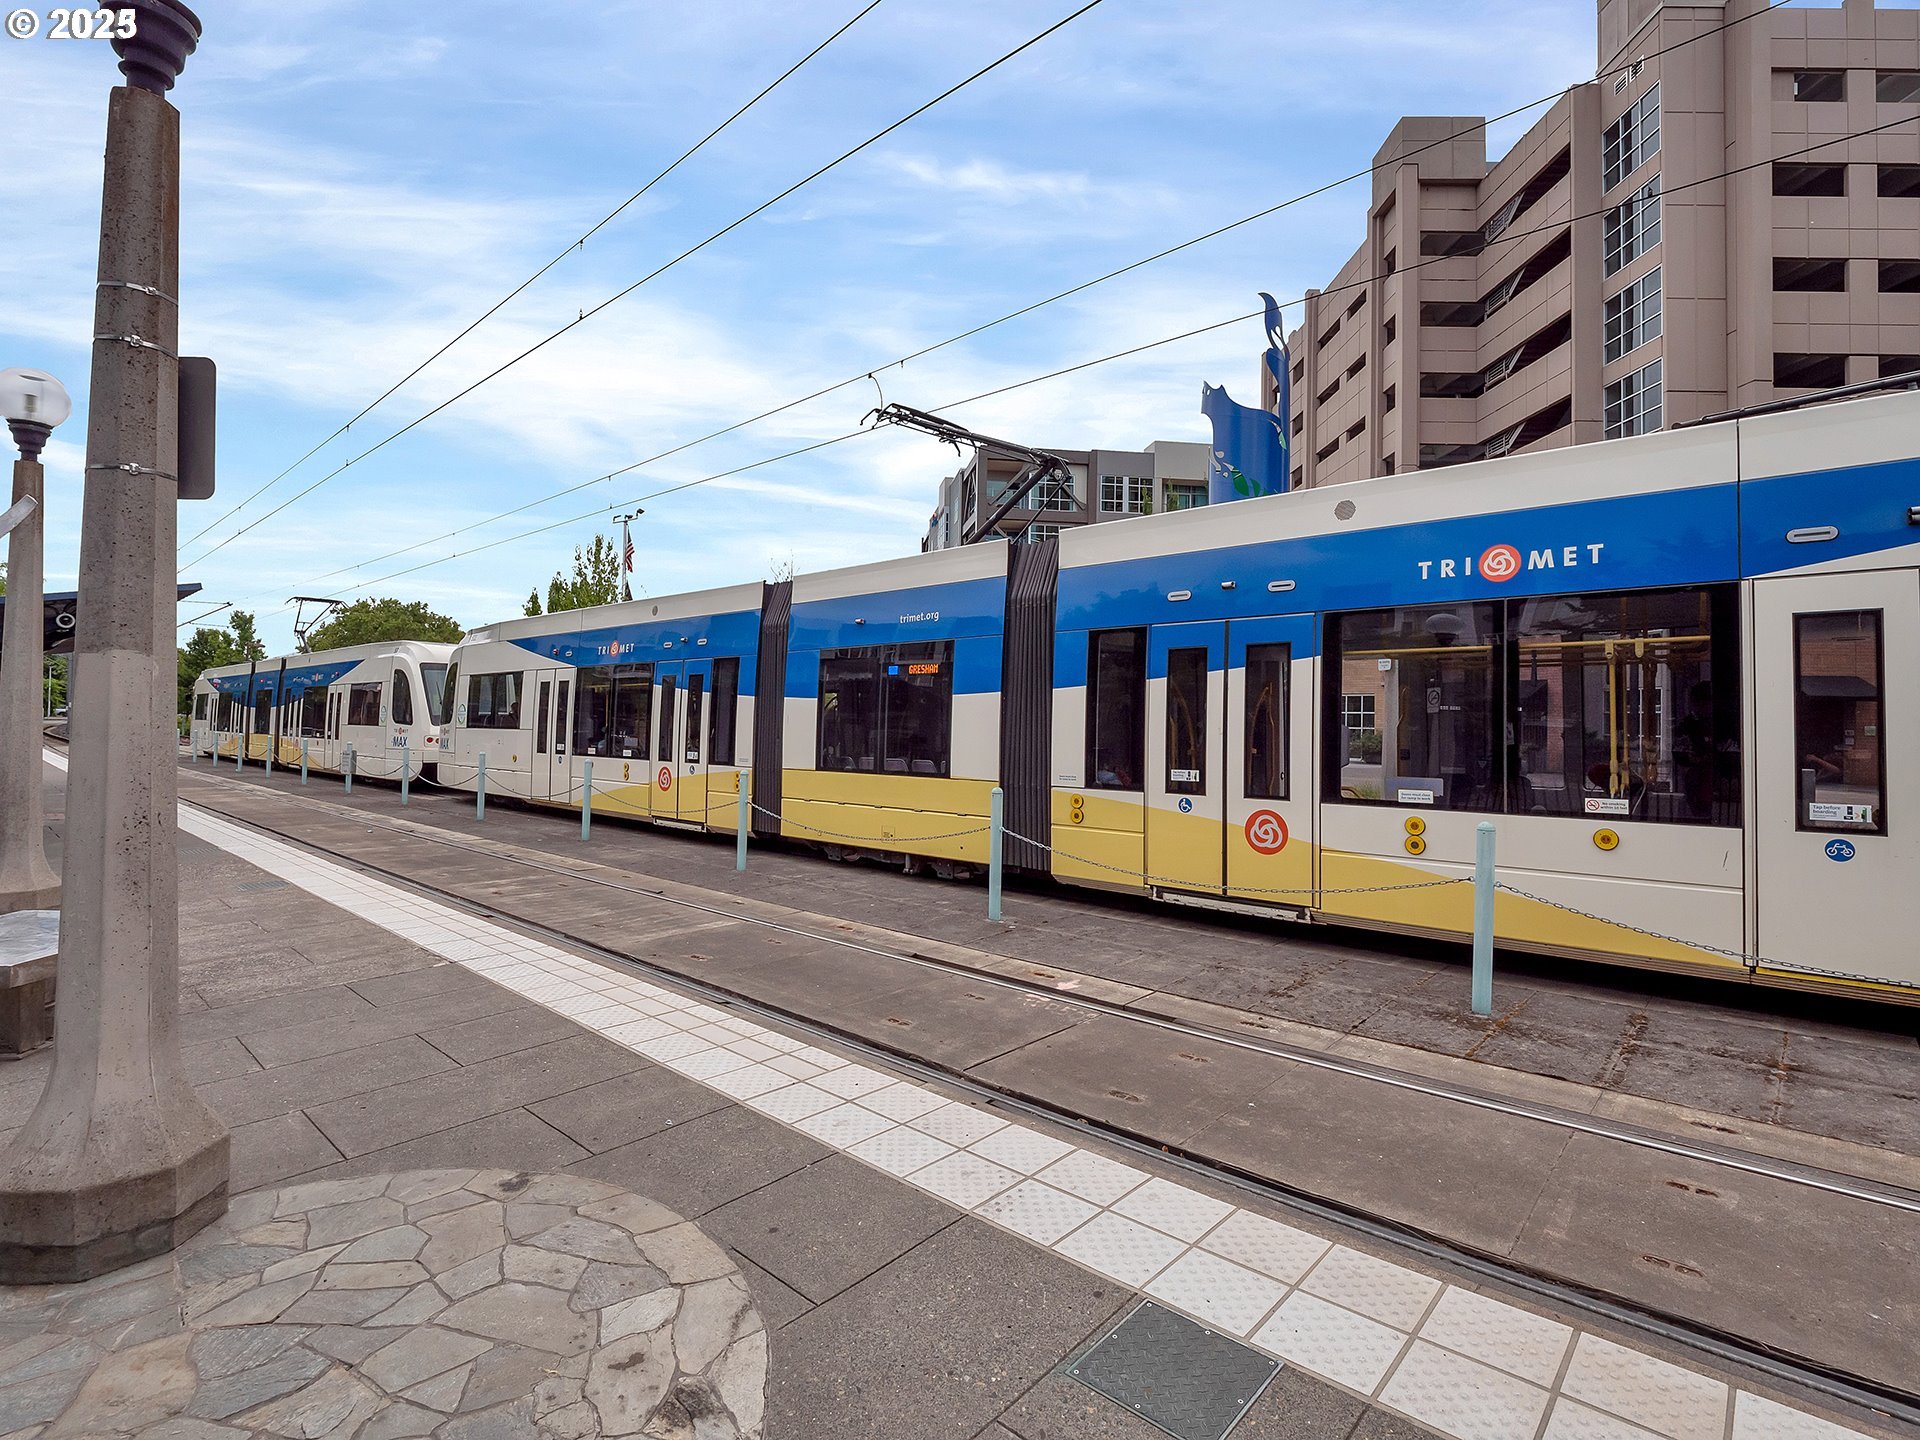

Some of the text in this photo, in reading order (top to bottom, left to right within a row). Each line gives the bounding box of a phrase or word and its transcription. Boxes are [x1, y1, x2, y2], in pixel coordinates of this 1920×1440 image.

[1418, 543, 1604, 580] TRI MET
[900, 611, 939, 624] trimet.org
[619, 643, 635, 653] MET
[908, 663, 939, 675] GRESHAM
[392, 736, 408, 747] MAX
